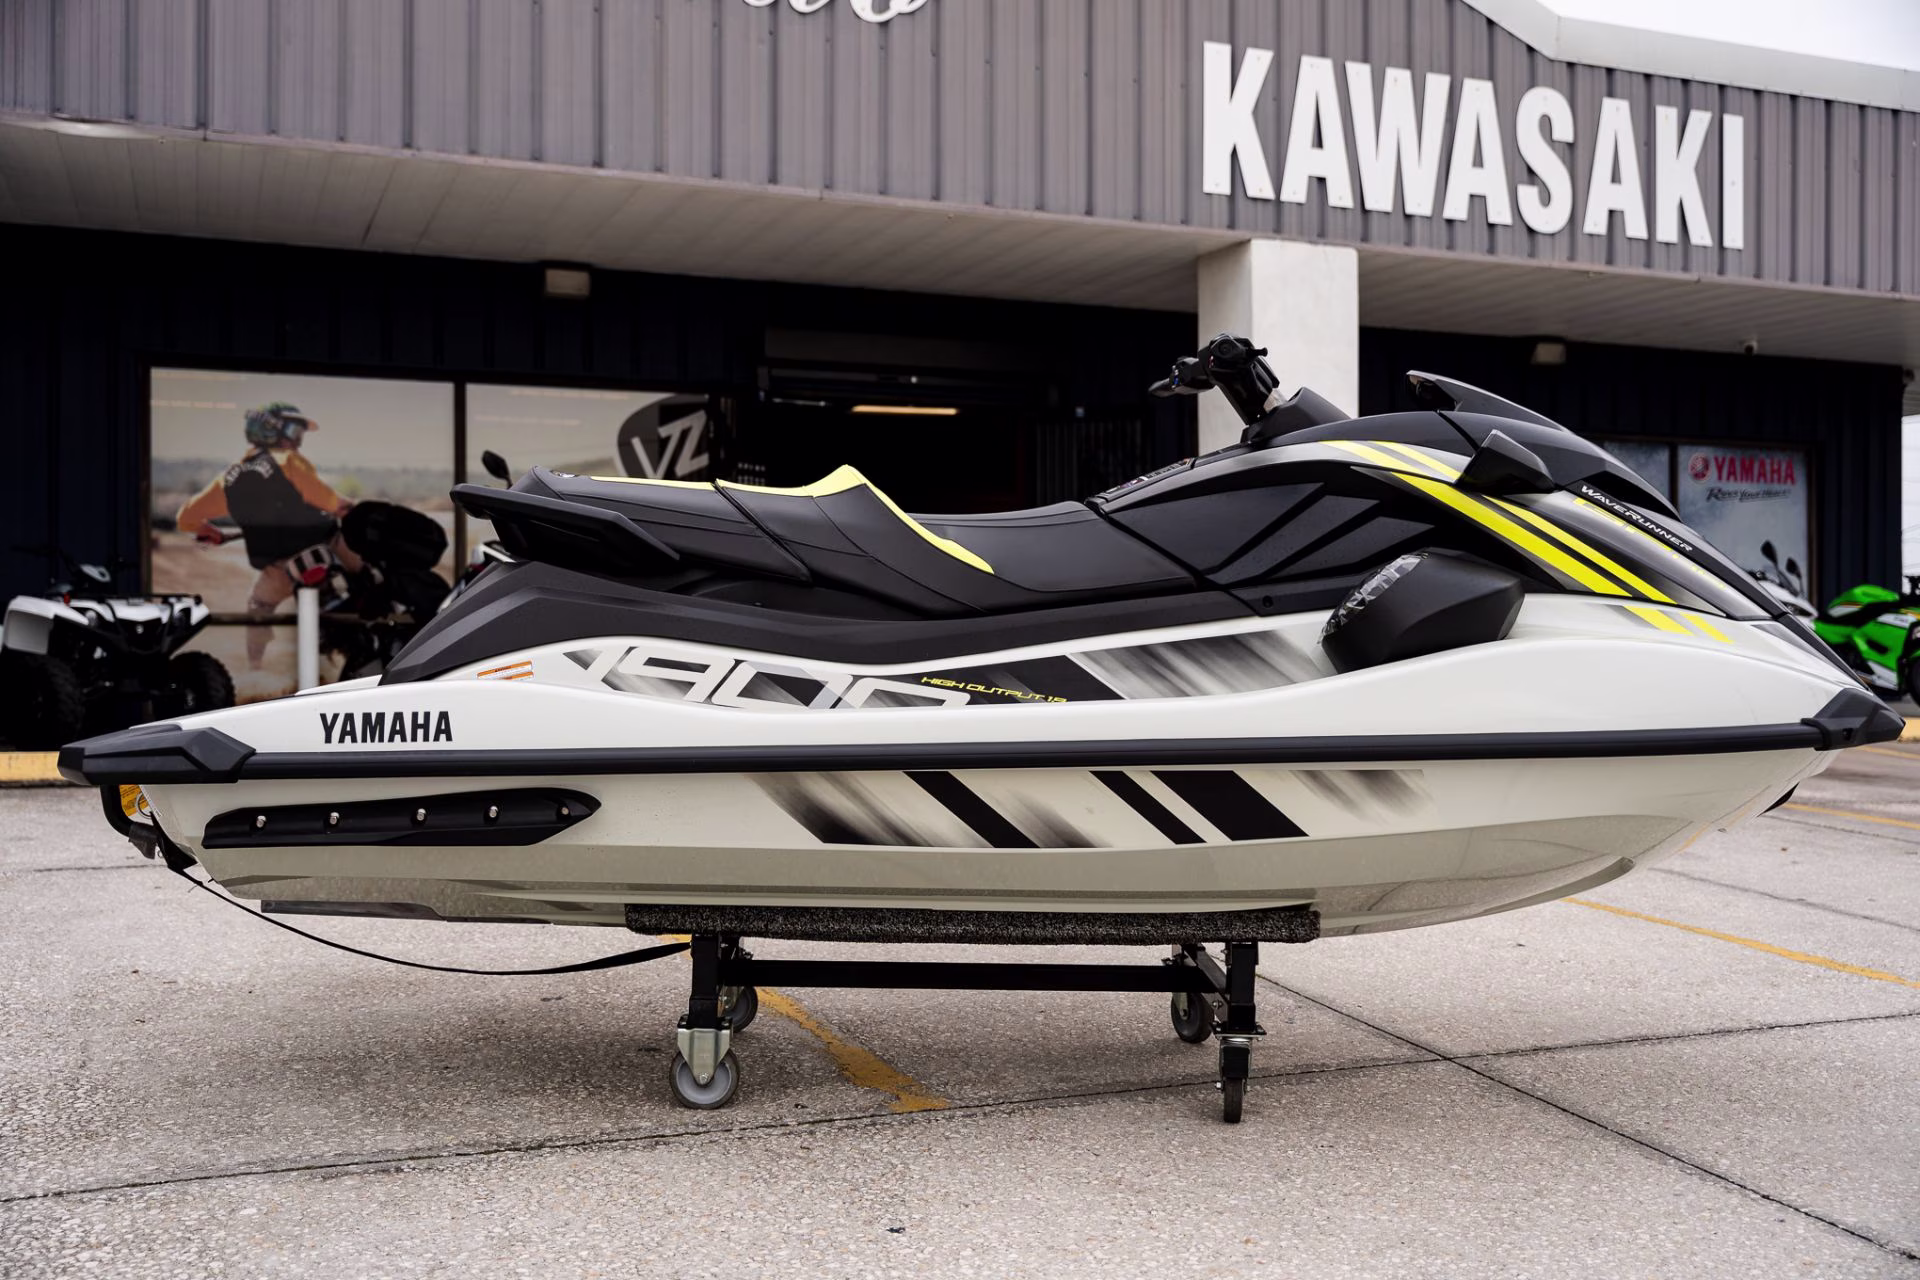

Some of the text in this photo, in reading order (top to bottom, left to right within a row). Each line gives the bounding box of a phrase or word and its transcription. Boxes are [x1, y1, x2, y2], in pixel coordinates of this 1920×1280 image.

[1203, 41, 1744, 250] KAWASAKI
[1713, 454, 1796, 485] YAMAHA
[1581, 485, 1694, 552] WAVERUNNER
[920, 676, 965, 690] HIGH
[966, 682, 1046, 701] OUTPUT
[319, 711, 453, 745] YAMAHA
